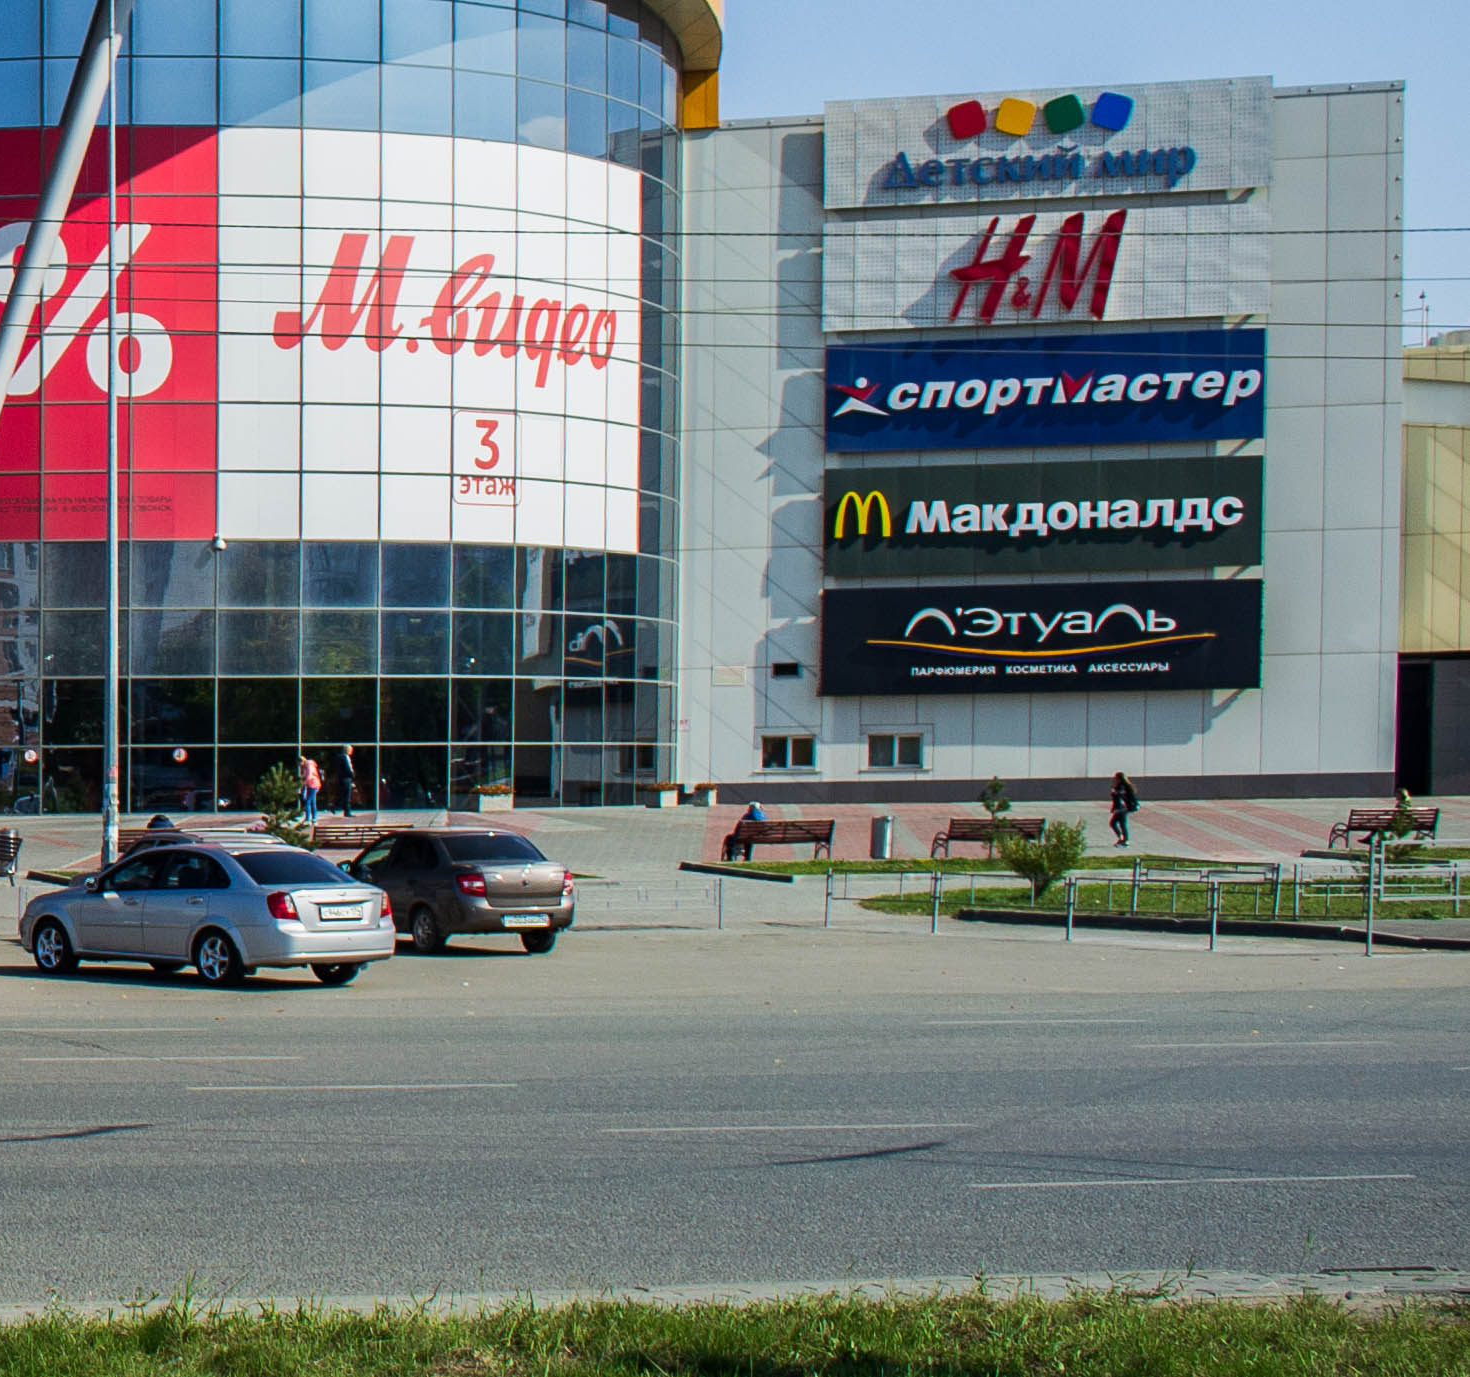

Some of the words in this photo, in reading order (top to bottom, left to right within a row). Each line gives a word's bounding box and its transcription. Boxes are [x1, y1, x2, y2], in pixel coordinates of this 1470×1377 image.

[883, 144, 1082, 189] Детский
[1094, 145, 1196, 190] мир
[949, 209, 1126, 323] H&M
[273, 233, 617, 388] М.видео
[474, 418, 500, 470] 3
[459, 475, 516, 497] этаж
[905, 495, 1245, 537] Макдоналдс
[911, 665, 996, 676] ПАРФЮМЕРИЯ
[1005, 663, 1077, 674] КОСМЕТИКА
[1087, 662, 1170, 673] АКСЕССУАРЫ
